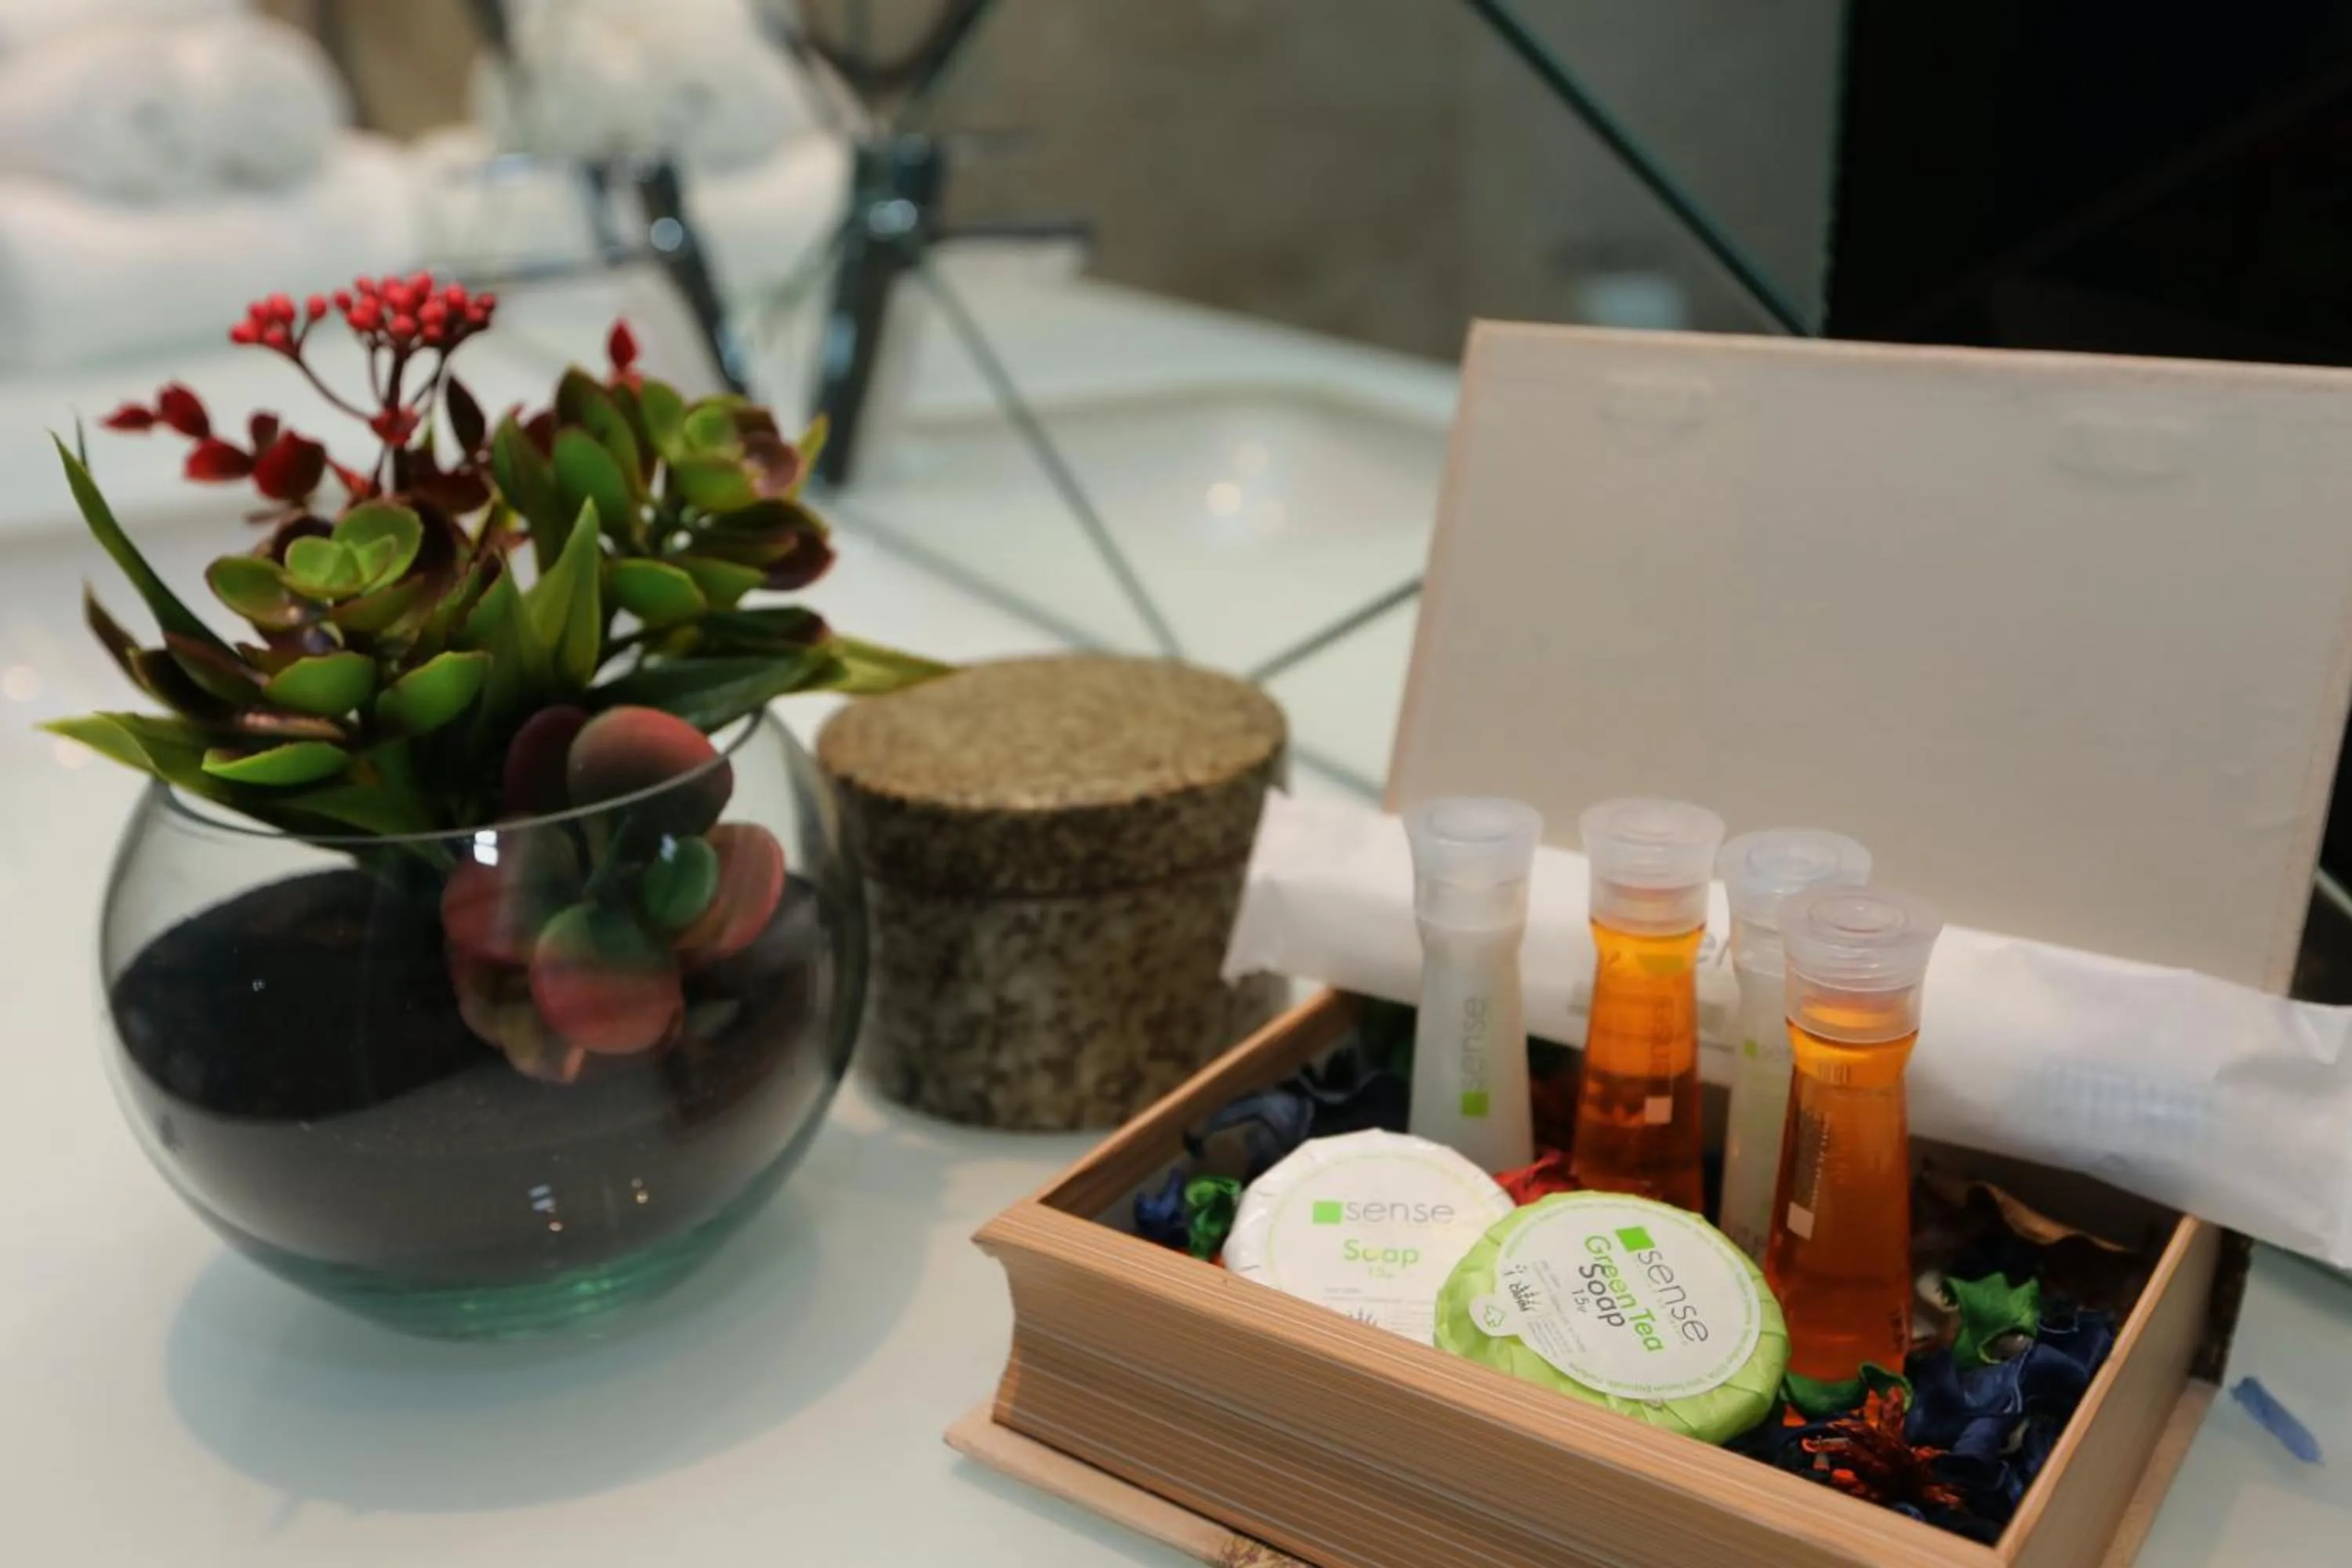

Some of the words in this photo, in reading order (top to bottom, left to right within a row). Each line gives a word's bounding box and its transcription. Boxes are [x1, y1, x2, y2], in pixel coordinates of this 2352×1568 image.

[1460, 996, 1486, 1090] sense
[1345, 1201, 1455, 1223] sense
[1344, 1239, 1421, 1266] Soap
[1578, 1263, 1625, 1327] Soap
[1584, 1235, 1637, 1308] Green
[1628, 1308, 1664, 1352] Tea
[1638, 1250, 1708, 1342] sense
